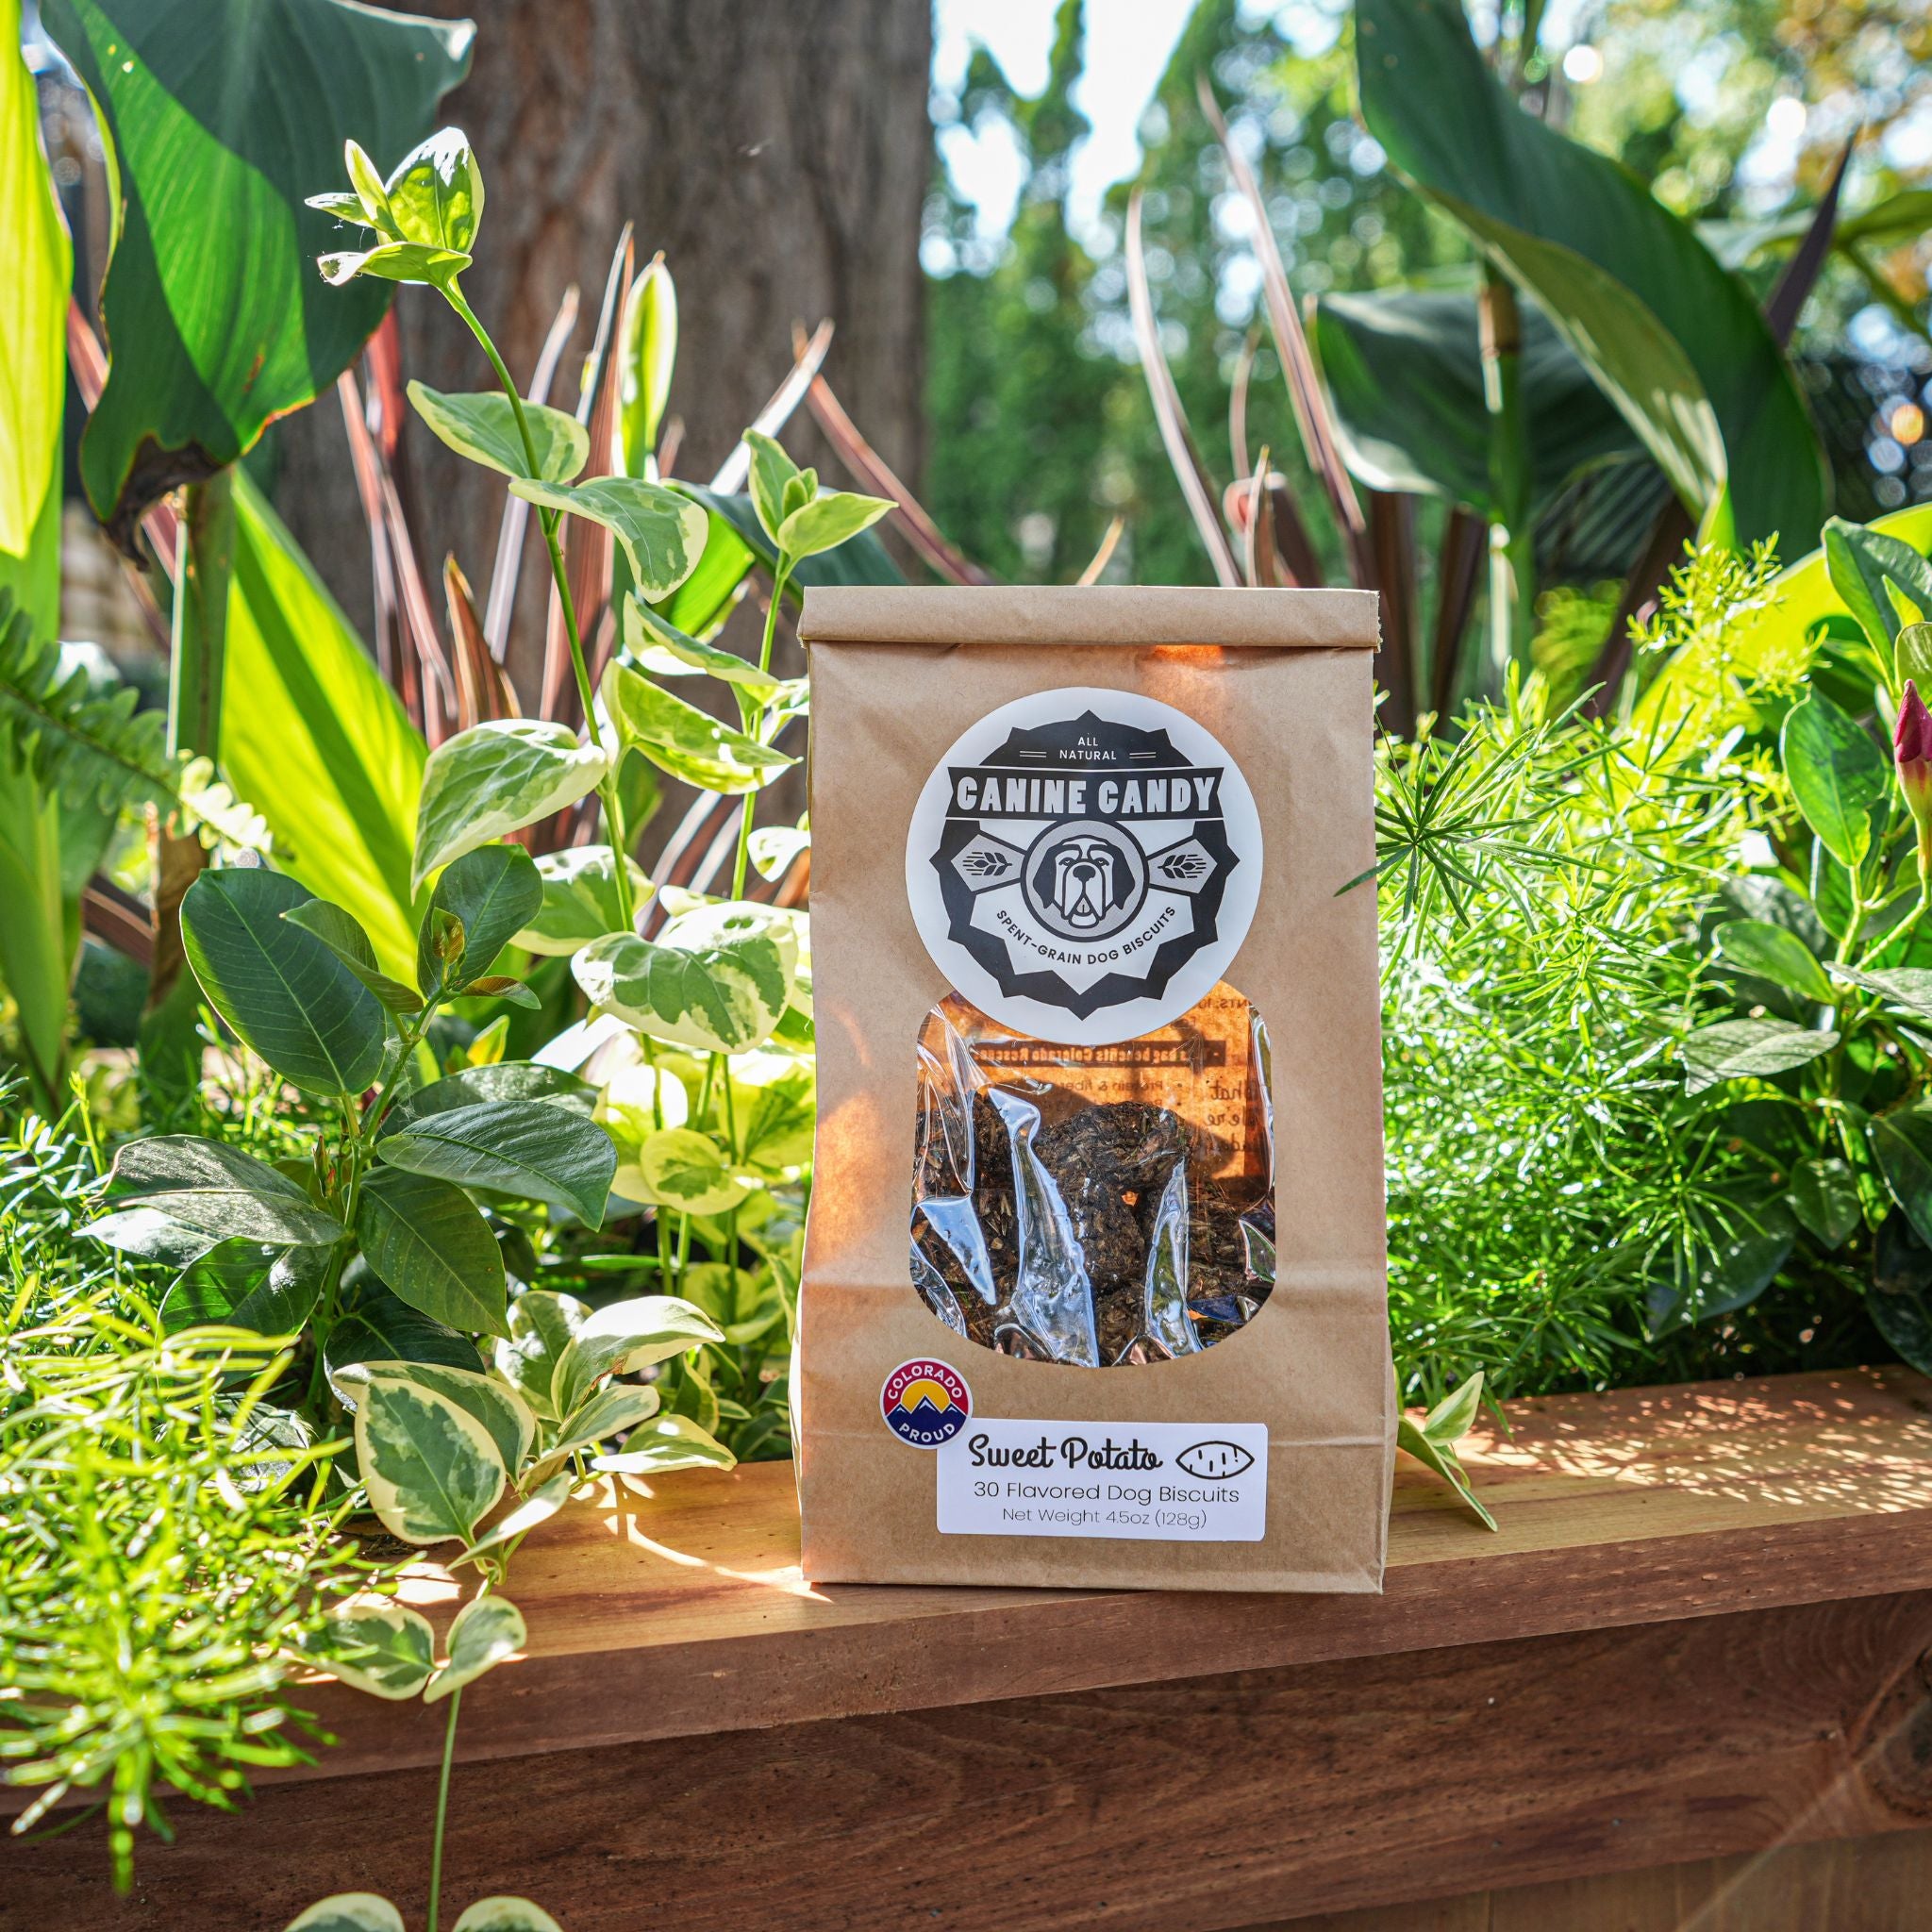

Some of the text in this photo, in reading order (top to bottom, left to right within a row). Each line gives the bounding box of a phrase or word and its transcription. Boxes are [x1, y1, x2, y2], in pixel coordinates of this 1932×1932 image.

[1077, 736, 1099, 746] ALL
[1059, 749, 1117, 760] NATURAL
[957, 776, 1216, 814] CANINE CANDY
[996, 906, 1176, 965] SPENT-GRAIN DOG BISCUITS
[888, 1364, 963, 1400] COLORADO
[899, 1423, 955, 1442] PROUD
[968, 1433, 1164, 1471] Sweet Potato
[974, 1481, 1240, 1506] 30 Flavored Dog Biscuits
[1002, 1508, 1032, 1522] Net
[1039, 1508, 1101, 1526] Weight
[1155, 1509, 1207, 1530] (128g)
